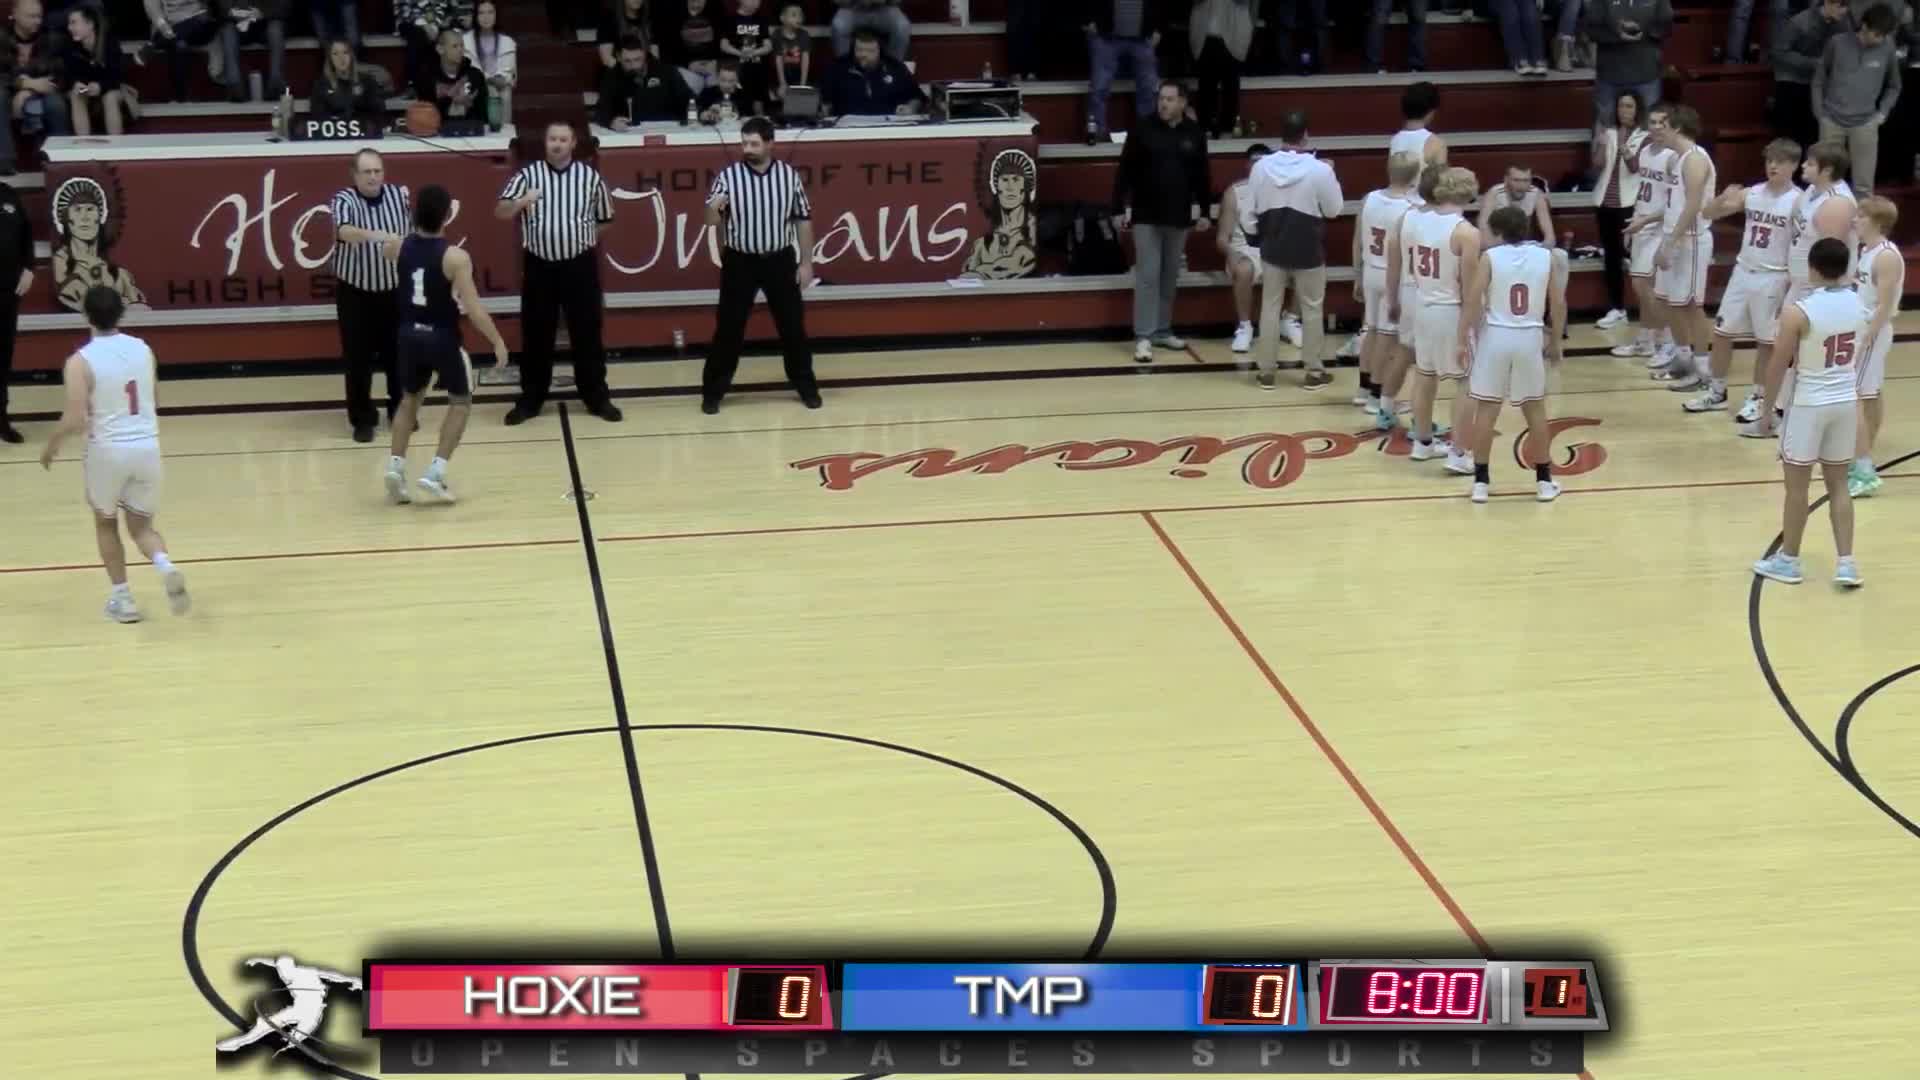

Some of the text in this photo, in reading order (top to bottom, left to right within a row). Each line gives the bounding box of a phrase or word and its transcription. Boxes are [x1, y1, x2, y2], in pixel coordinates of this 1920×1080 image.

[306, 120, 365, 138] POSS.
[636, 168, 722, 192] HO
[860, 161, 944, 186] THE
[606, 186, 969, 275] Inans
[1749, 225, 1773, 249] 13
[168, 275, 285, 305] HIGH
[411, 266, 428, 307] 1
[1509, 283, 1530, 316] 0
[1822, 331, 1856, 369] 15
[124, 377, 140, 416] 1
